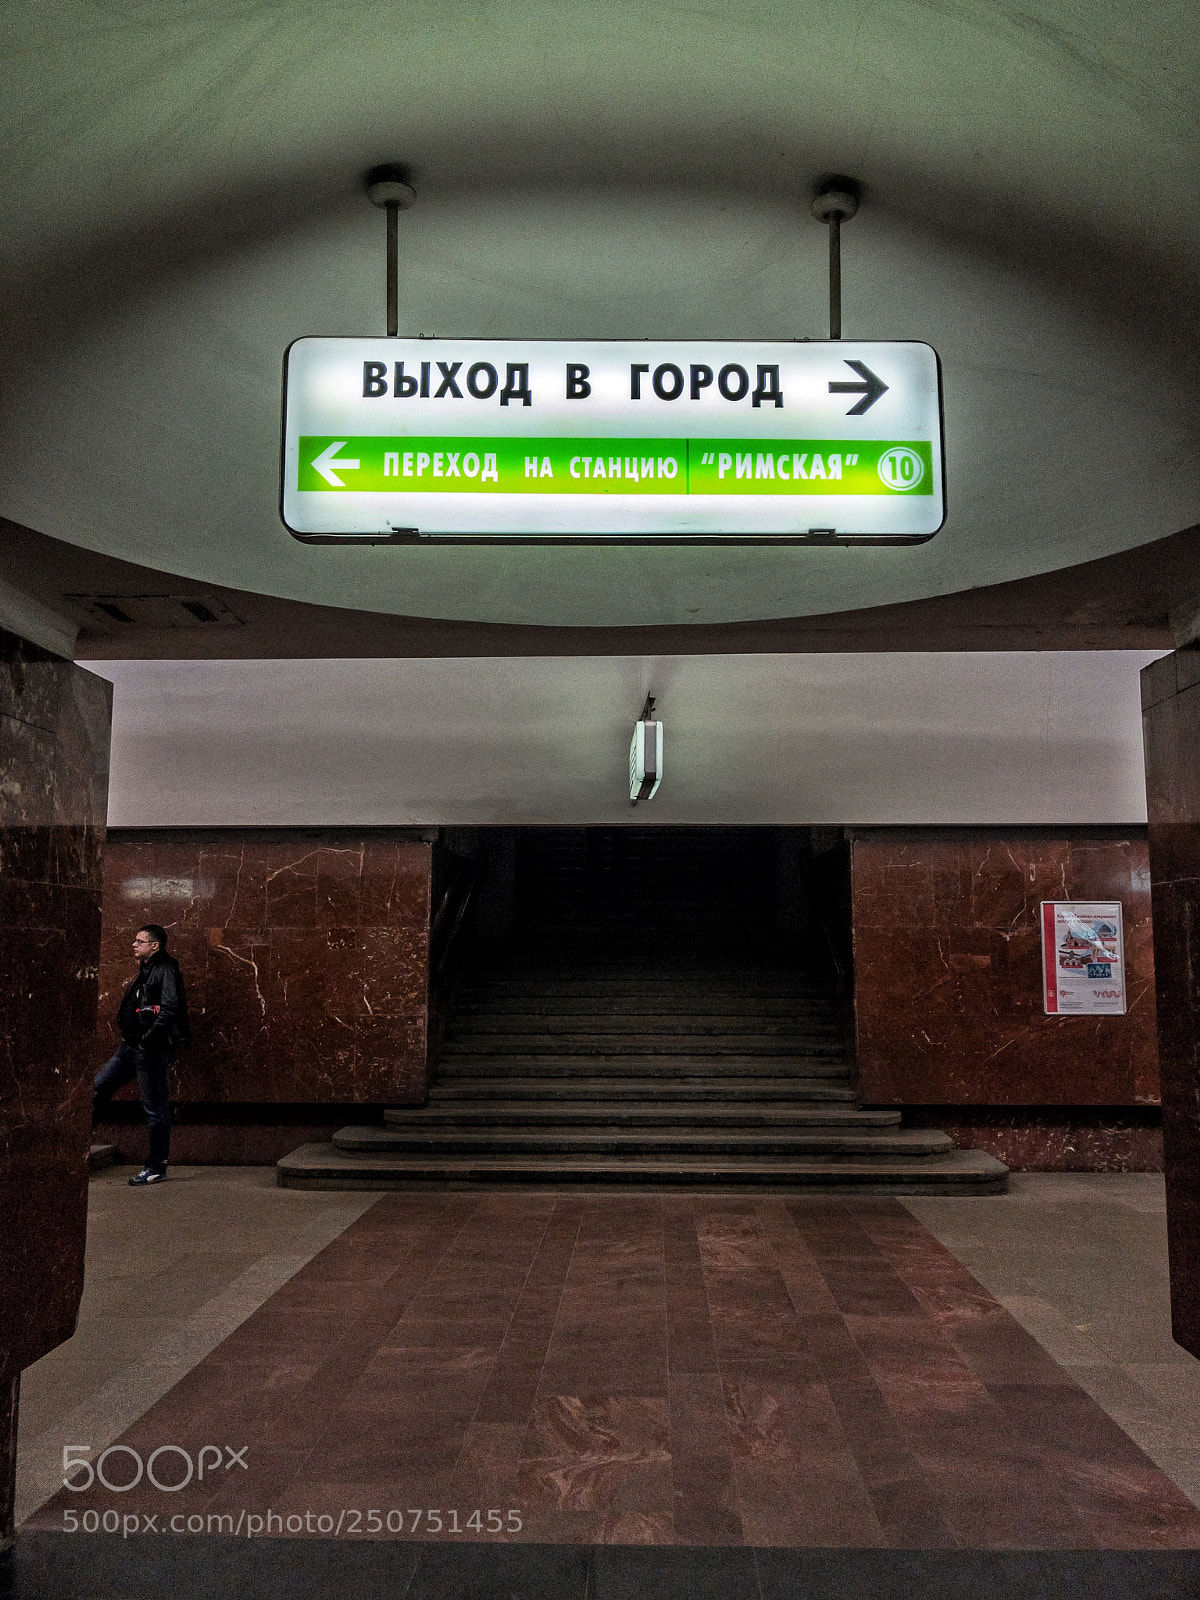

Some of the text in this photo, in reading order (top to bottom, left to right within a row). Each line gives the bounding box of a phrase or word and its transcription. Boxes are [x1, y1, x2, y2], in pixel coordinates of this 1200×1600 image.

[363, 361, 784, 409] ВЫХОД В ГОРОД
[384, 452, 498, 482] ПЕРЕХОД
[524, 456, 554, 478] НА
[569, 457, 678, 483] СТАНЦИЮ
[888, 455, 914, 481] 10
